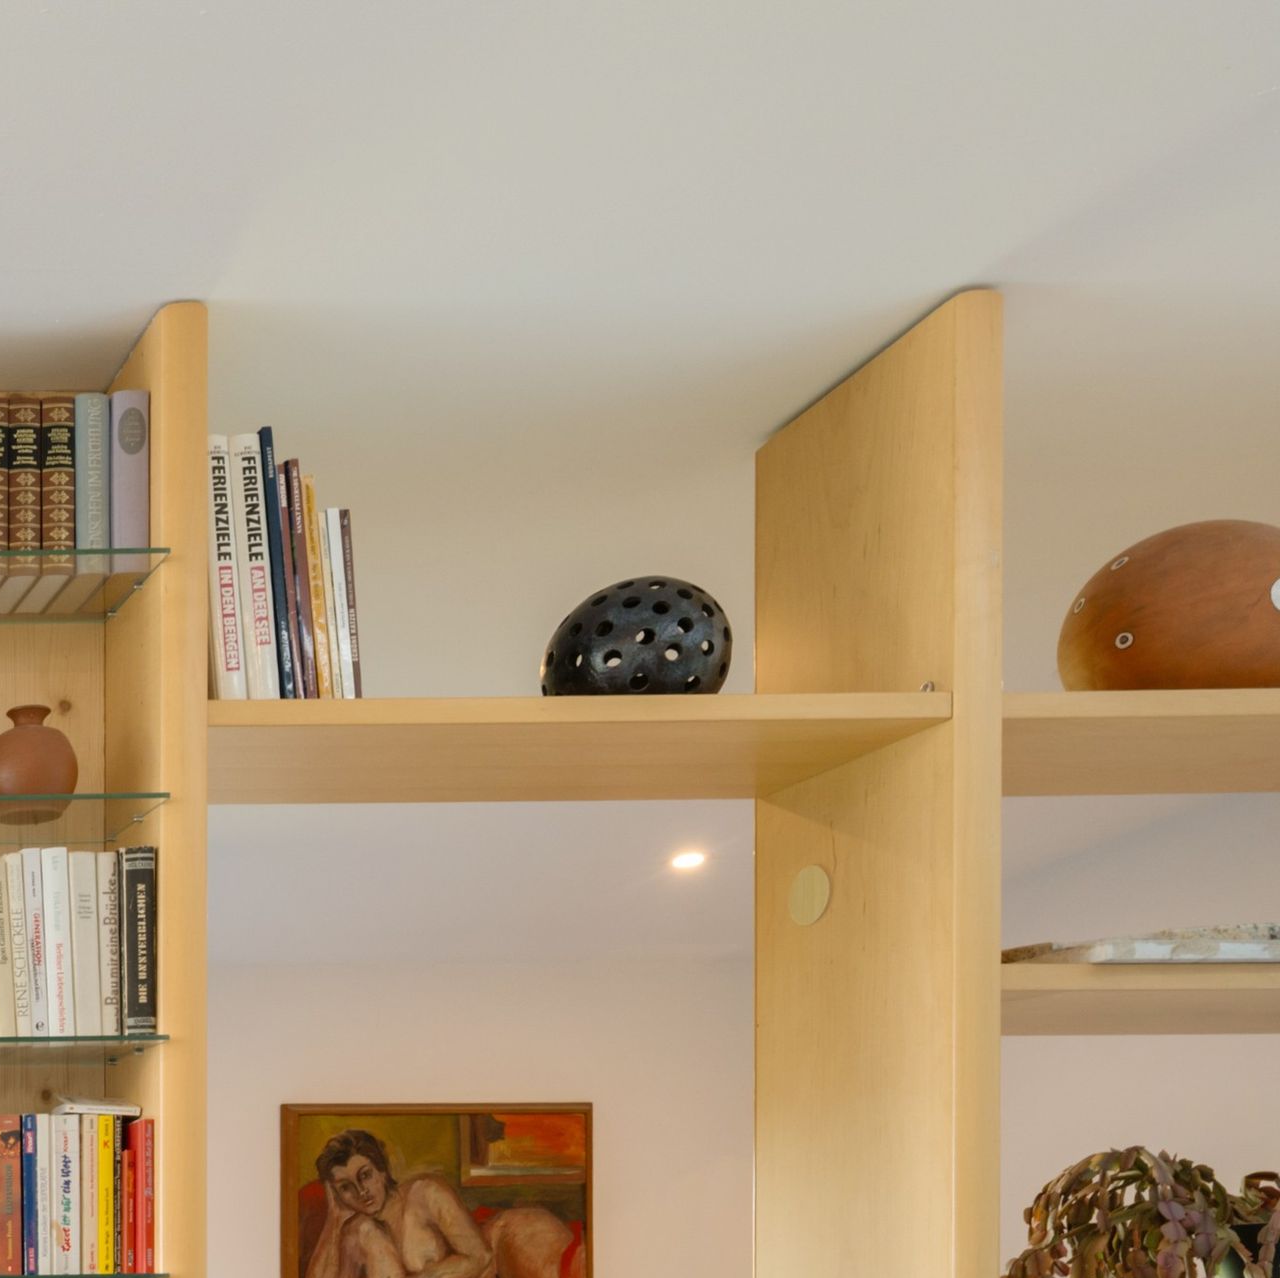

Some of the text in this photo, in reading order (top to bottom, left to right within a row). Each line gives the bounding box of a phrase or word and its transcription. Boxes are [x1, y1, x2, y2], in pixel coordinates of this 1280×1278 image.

[87, 470, 102, 487] IM
[278, 473, 287, 507] MOSKAU
[211, 456, 239, 668] FERIENZIELE IN DEN BERGEN
[242, 456, 270, 644] FERIENZIELE AN DER SEE
[348, 608, 357, 634] KATZEN
[11, 906, 27, 976] SCHICKELE
[33, 912, 42, 967] GENERATION
[102, 878, 118, 1006] Bau mir eine Brücke
[136, 883, 148, 1003] DIE UNSTERBLICHEN
[61, 1154, 71, 1178] Wort
[61, 1178, 71, 1194] ein
